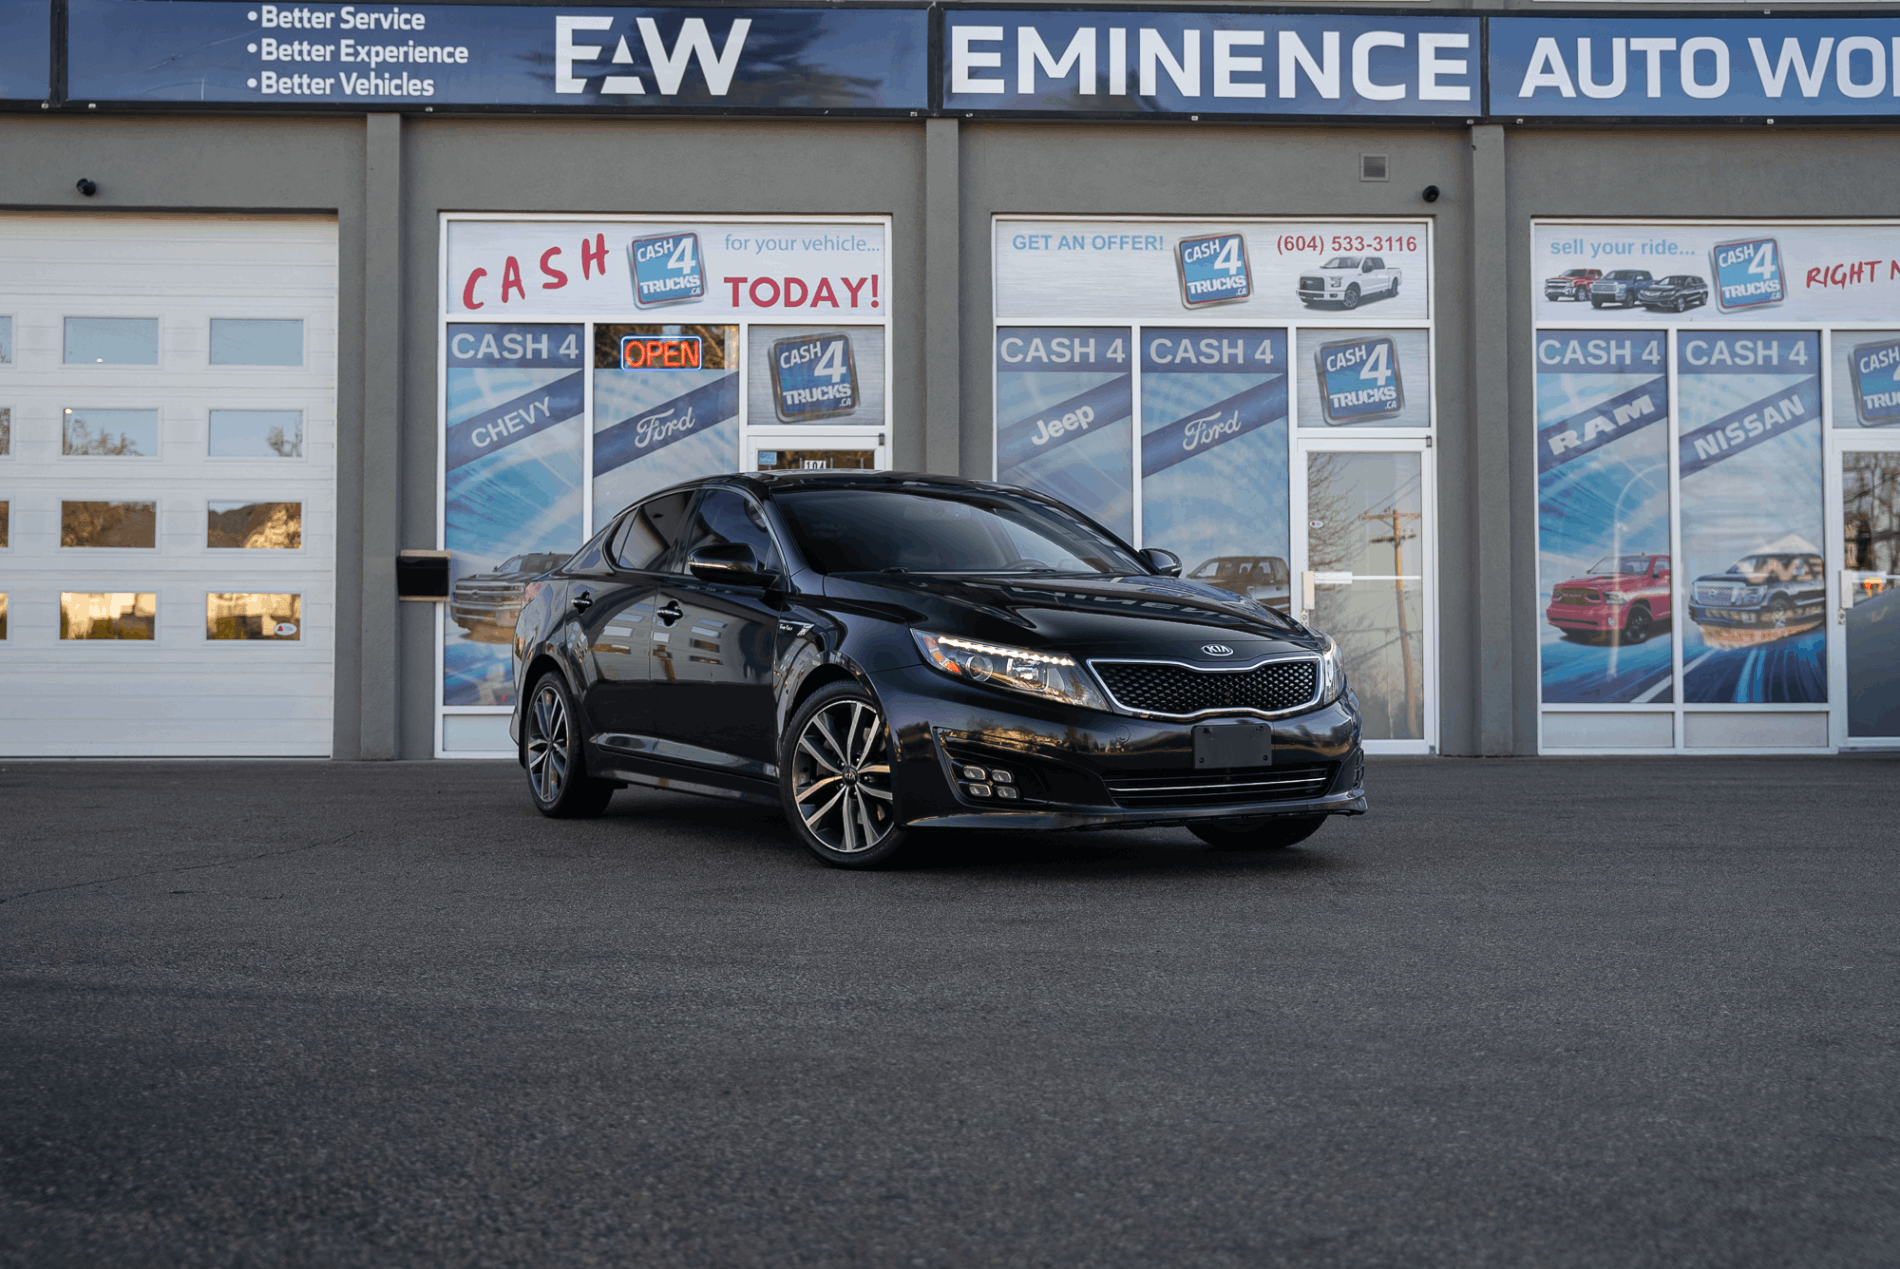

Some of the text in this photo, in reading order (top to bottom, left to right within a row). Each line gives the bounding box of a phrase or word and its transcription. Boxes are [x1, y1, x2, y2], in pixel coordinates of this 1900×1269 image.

[262, 5, 426, 30] Better Service
[261, 38, 469, 68] Better Experience
[951, 25, 1900, 101] EMINENCE AUTO WO
[261, 71, 435, 96] Better Vehicles
[637, 237, 696, 275] CASH 4
[725, 234, 881, 255] for your vehicle...
[1012, 235, 1164, 251] GET AN OFFER!
[1184, 238, 1242, 275] CASH 4
[1277, 235, 1418, 255] (604) 533-3116
[1550, 239, 1696, 259] sell your ride...
[463, 233, 609, 310] CASH
[1719, 242, 1776, 280] CASH 4
[1806, 260, 1882, 289] RIGHT
[640, 274, 701, 294] TRUCKS
[724, 274, 880, 309] TODAY!
[1187, 275, 1247, 294] TRUCKS
[1722, 279, 1781, 299] TRUCKS
[451, 333, 579, 360] CASH 4
[624, 340, 700, 369] OPEN
[1000, 337, 1126, 363] CASH 4
[1149, 338, 1274, 364] CASH 4
[1538, 339, 1661, 365] CASH 4
[1685, 340, 1808, 366] CASH 4
[780, 340, 847, 383] CASH 4
[1326, 343, 1392, 386] CASH 4
[782, 383, 852, 405] TRUCKS
[1329, 386, 1397, 408] TRUCKS
[471, 396, 551, 449] CHEVY
[634, 407, 696, 448] Ford
[1030, 405, 1095, 446] Jeep
[1182, 410, 1242, 451] Ford
[1548, 394, 1656, 456] RAM
[1693, 394, 1806, 460] NISSAN
